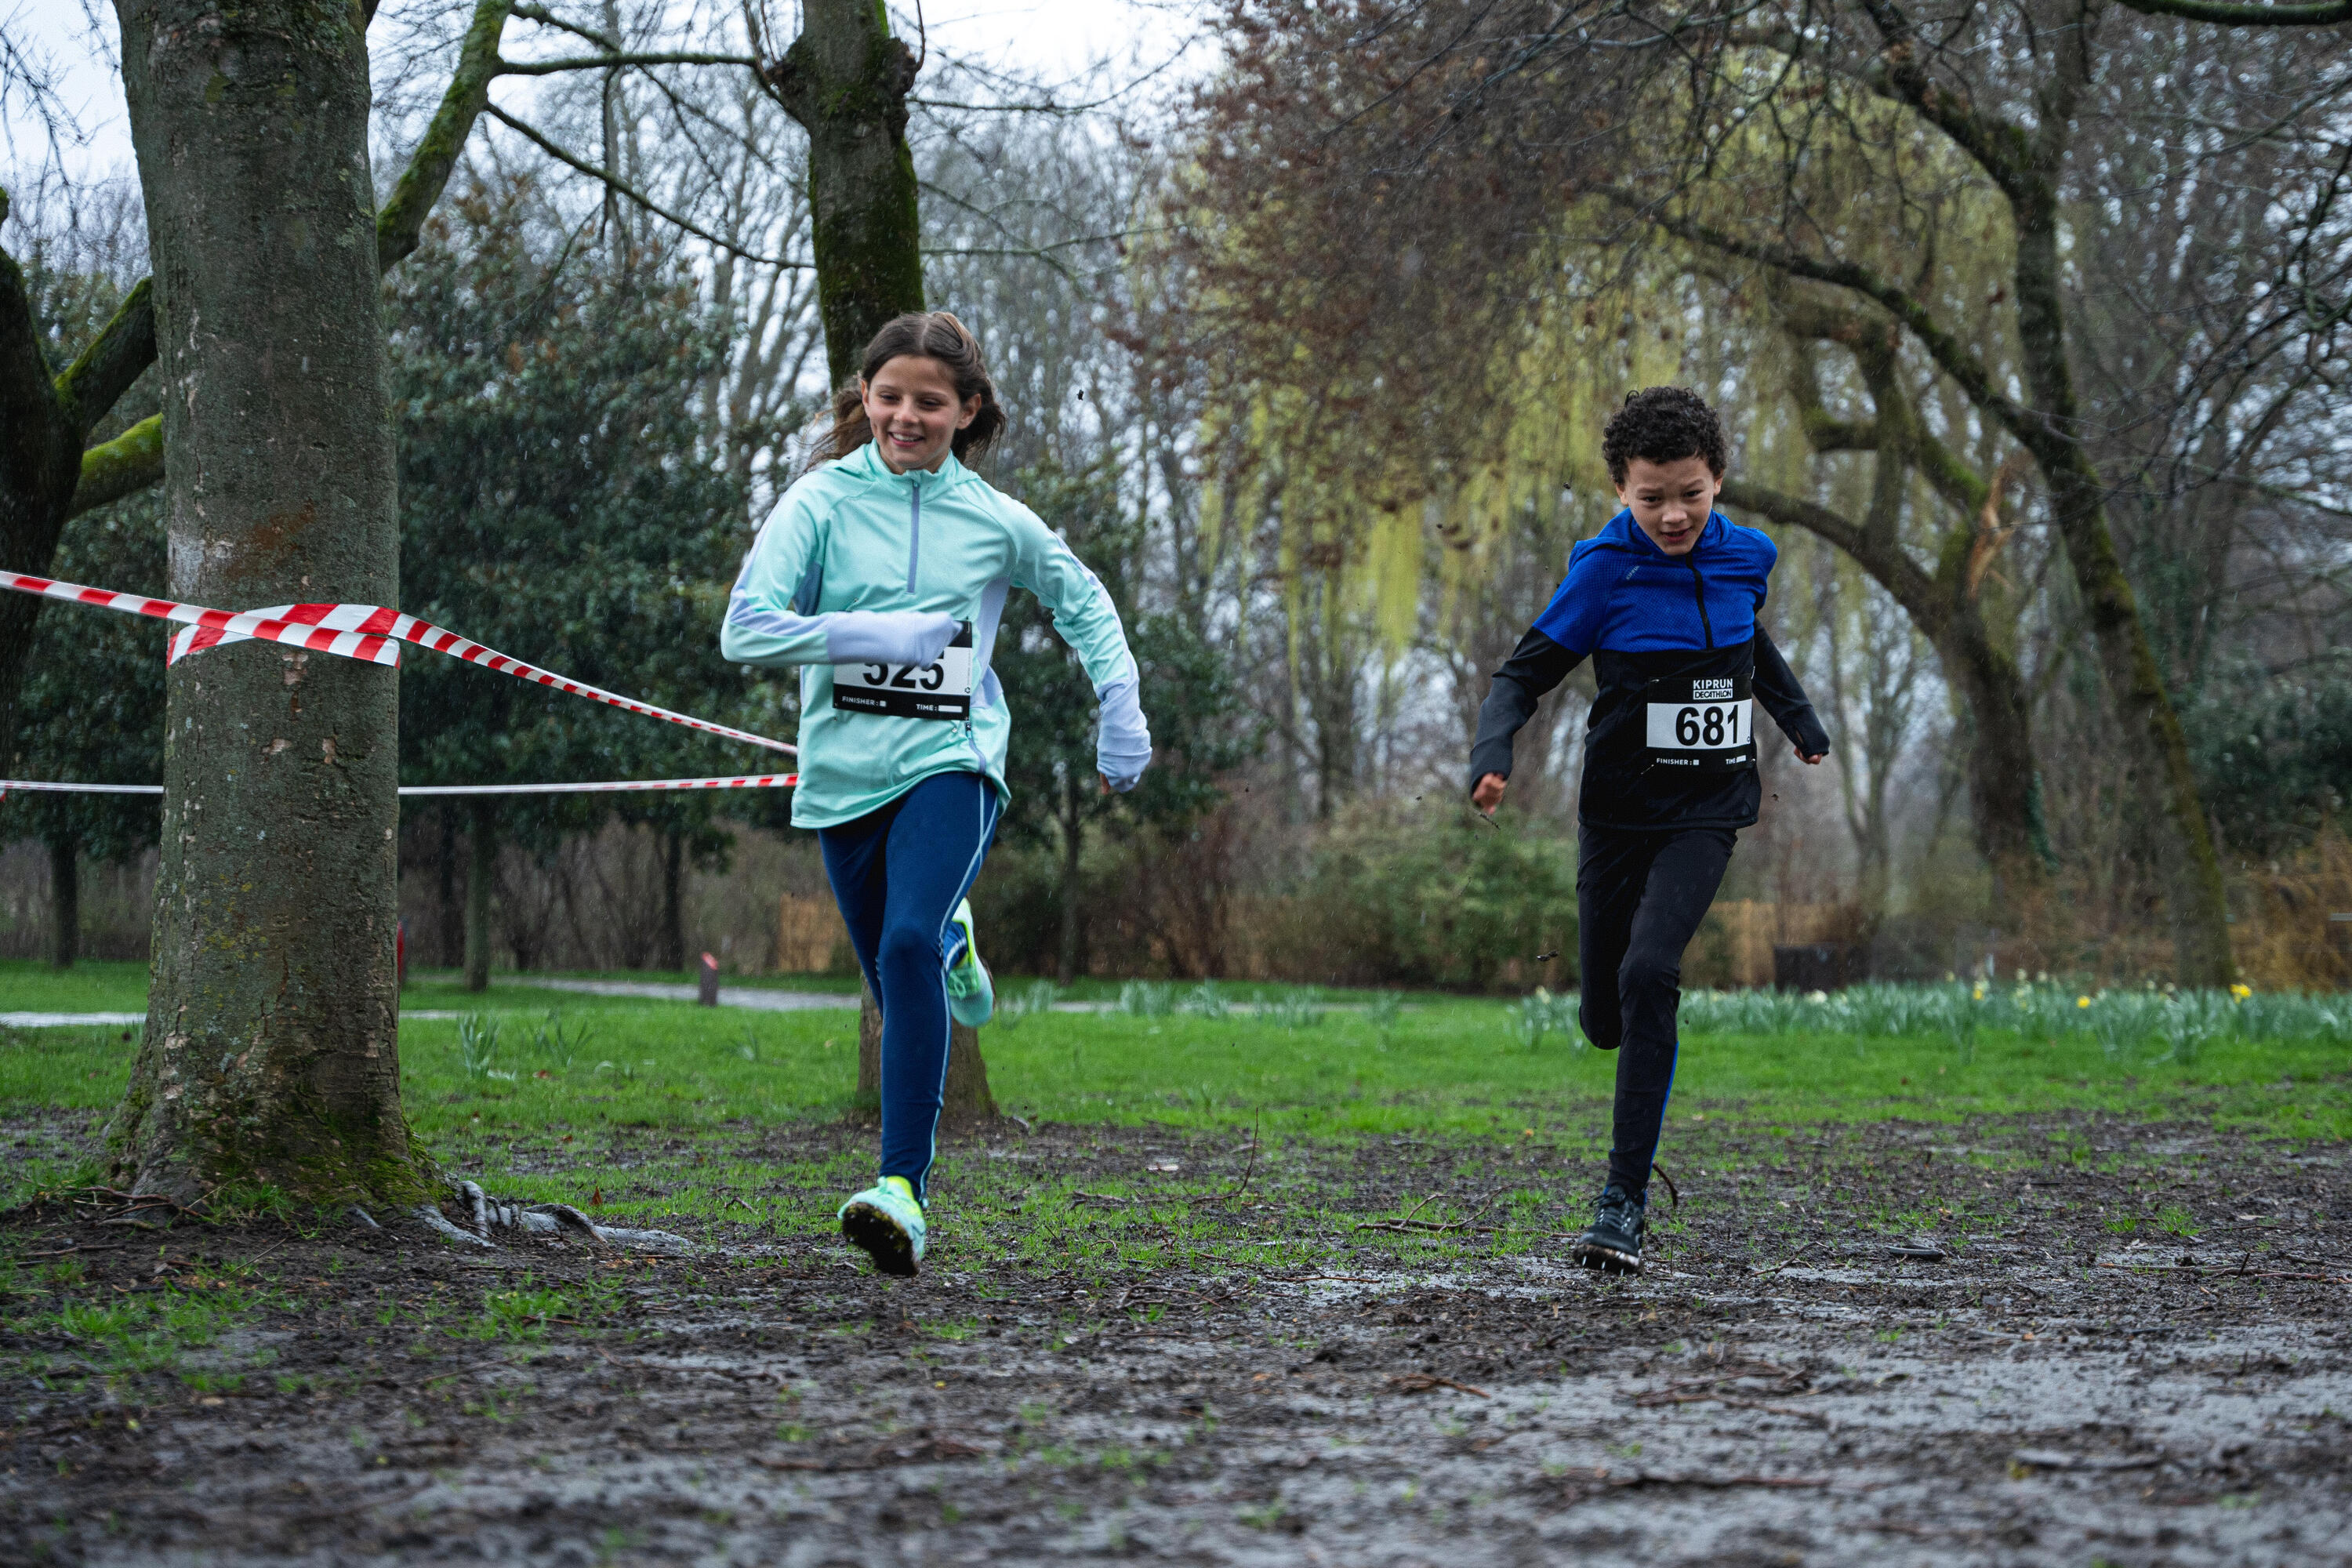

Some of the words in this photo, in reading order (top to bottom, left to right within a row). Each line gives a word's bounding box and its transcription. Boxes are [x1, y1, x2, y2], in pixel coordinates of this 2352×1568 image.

[1693, 678, 1733, 689] KIPRUN
[1694, 689, 1732, 699] DECATHLON
[1675, 704, 1738, 746] 681
